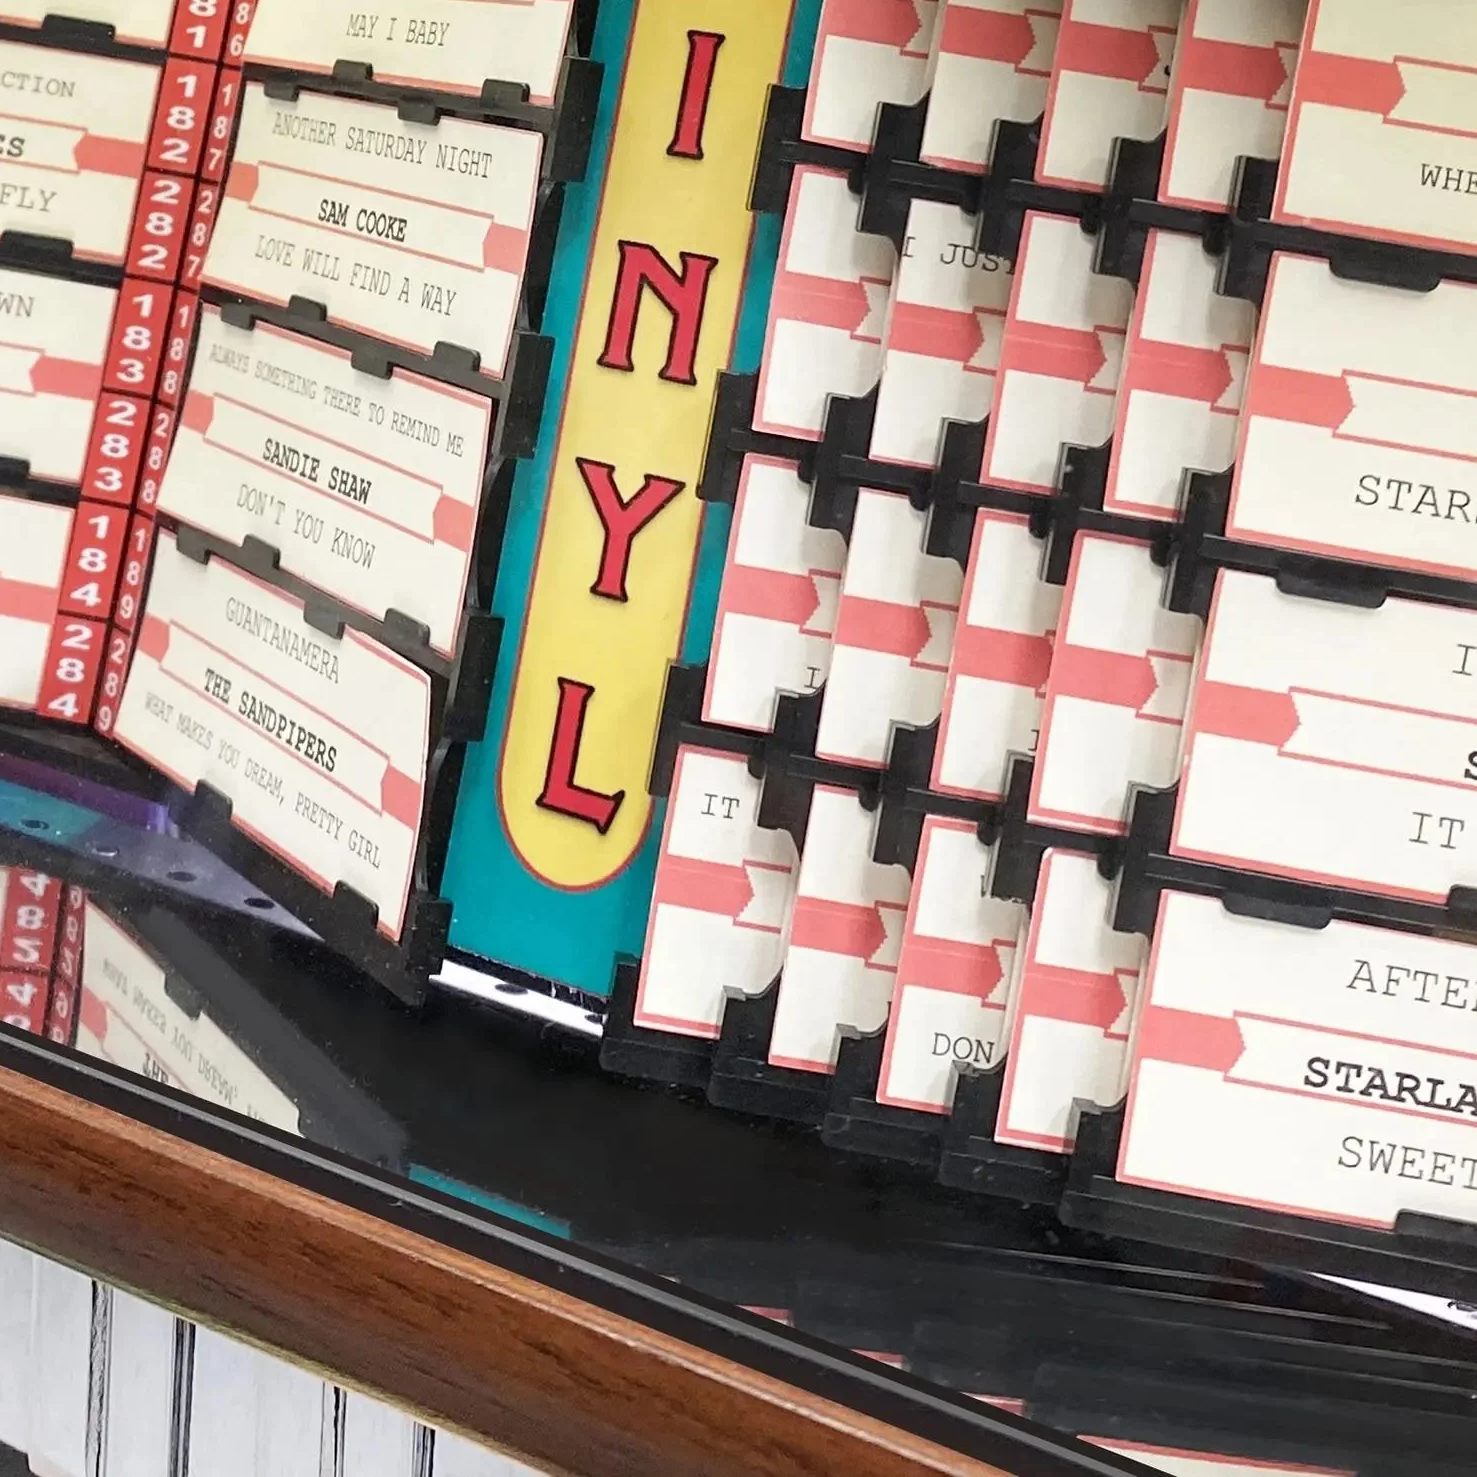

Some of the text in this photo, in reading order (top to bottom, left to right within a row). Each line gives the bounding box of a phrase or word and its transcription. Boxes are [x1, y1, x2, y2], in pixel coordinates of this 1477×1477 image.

[346, 13, 450, 47] MAY I BABY
[272, 112, 492, 178] ANOTHER SATURDAY NIGHT
[317, 199, 407, 243] SAM COOKE
[254, 234, 457, 317] LOVE WILL FIND A WAY
[209, 343, 464, 458] ALWAYS SOMETHING THERE TO REMIND ME
[262, 437, 373, 506] SANDIE SHAW
[1355, 474, 1477, 524] STAR
[236, 484, 376, 570] DON'T YOU KNOW
[225, 595, 340, 684] GUANTANAMERA
[204, 667, 338, 773] THE SANDPIPERS
[177, 711, 213, 751] MAKES
[218, 737, 238, 770] YOU
[244, 757, 284, 806] DREAM,
[295, 790, 343, 842] PRETTY
[348, 823, 381, 870] GIRL
[701, 792, 740, 820] IT
[1408, 811, 1465, 850] IT
[1346, 959, 1477, 1011] AFTE
[932, 1032, 995, 1064] DON
